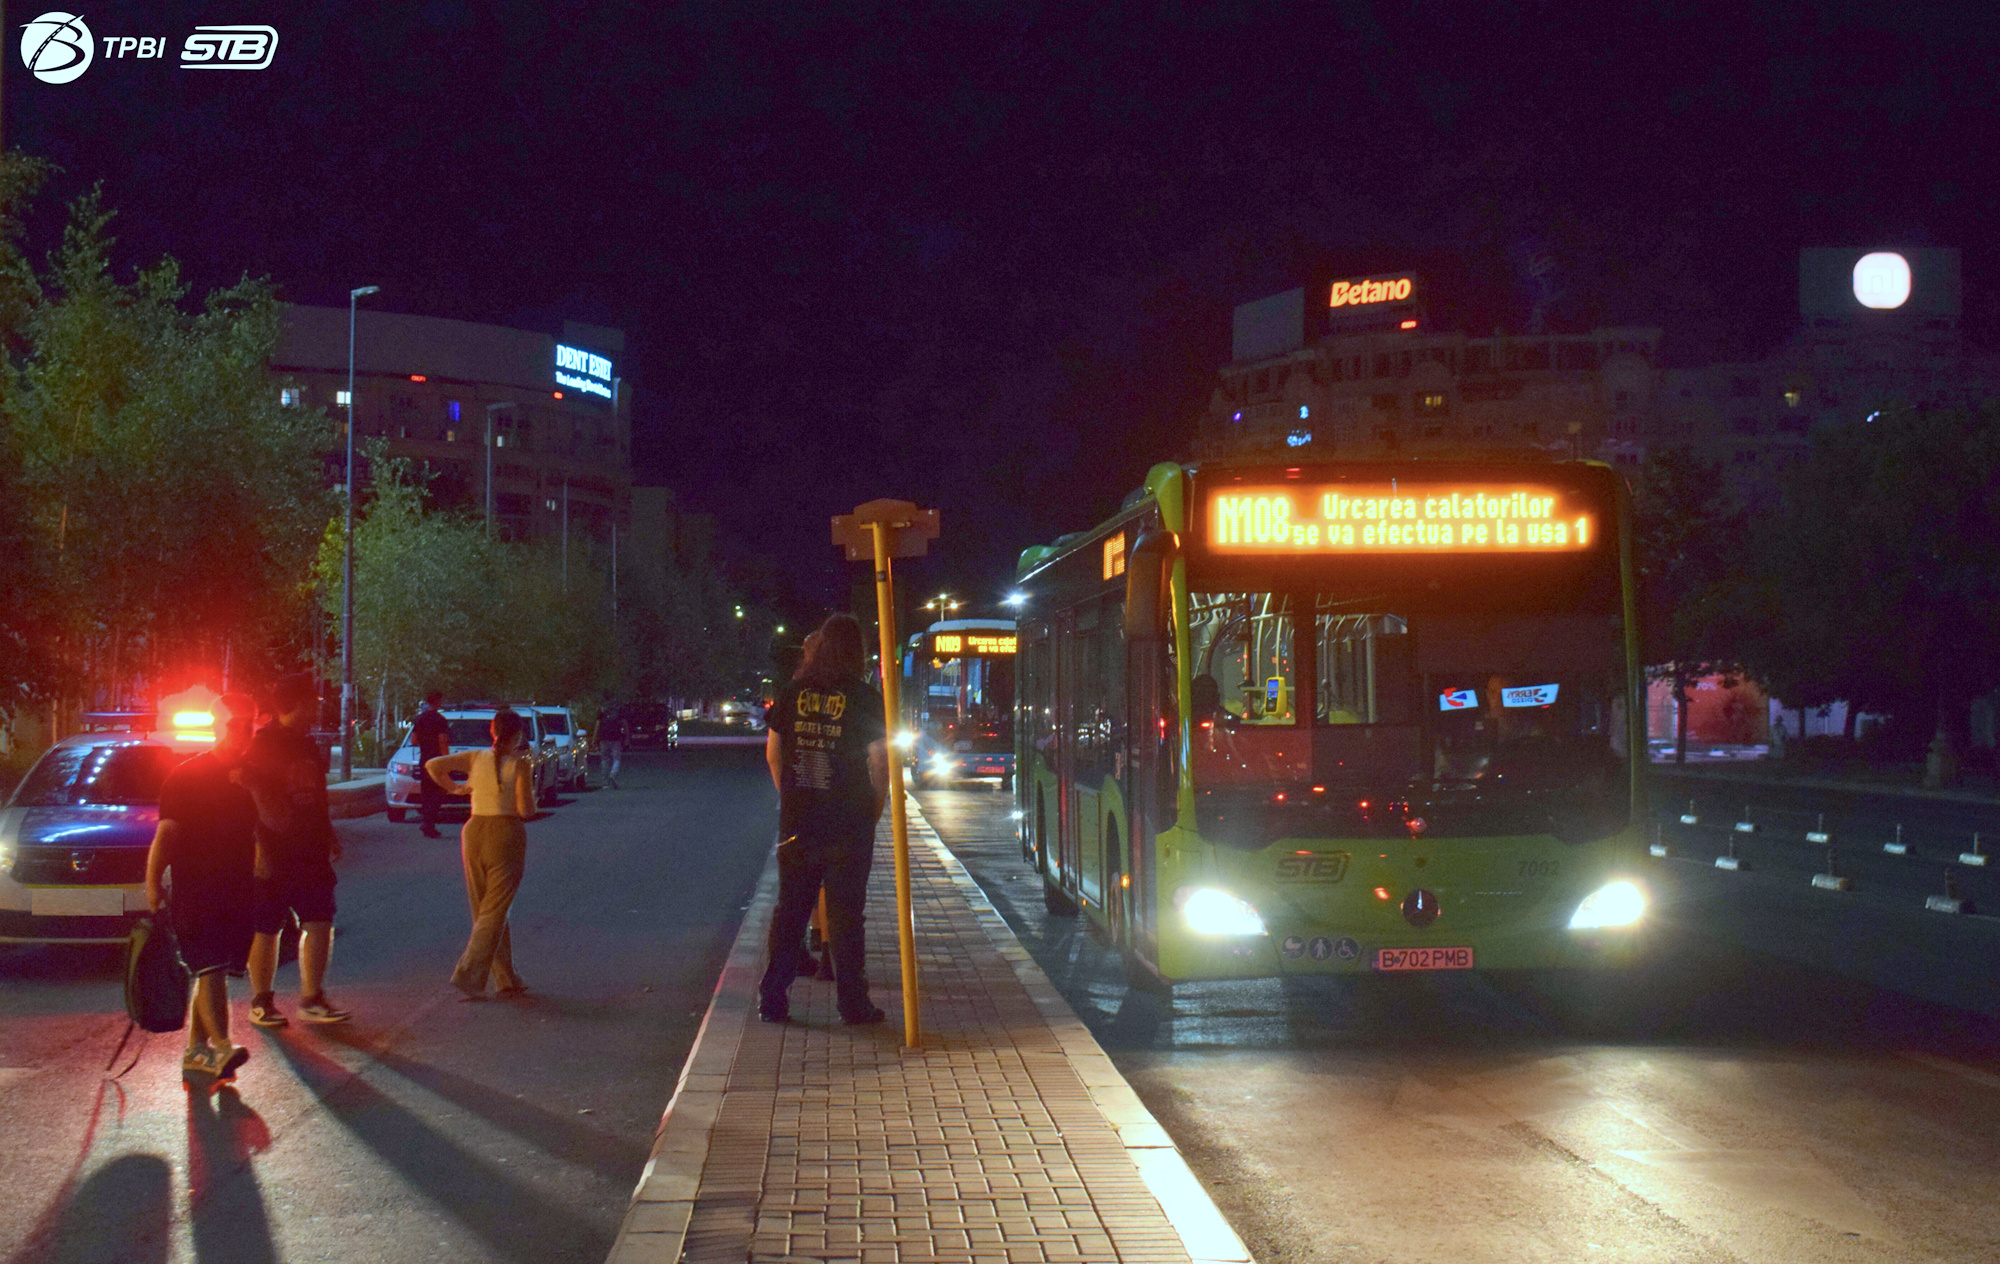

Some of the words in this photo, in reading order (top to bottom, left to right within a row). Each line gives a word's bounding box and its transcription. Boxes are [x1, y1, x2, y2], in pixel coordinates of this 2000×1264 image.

[1330, 279, 1411, 307] Betano
[556, 344, 588, 372] DENT
[1324, 494, 1416, 519] Urcarea
[1425, 493, 1555, 518] calatorilor
[1218, 497, 1290, 543] N108
[1293, 525, 1319, 545] se
[1328, 525, 1354, 545] va
[1363, 519, 1453, 545] efectua
[1462, 524, 1488, 544] pe
[1496, 519, 1519, 543] la
[1527, 524, 1568, 544] usa
[1575, 518, 1588, 544] 1
[1275, 856, 1341, 878] STB
[1432, 950, 1468, 967] PMB
